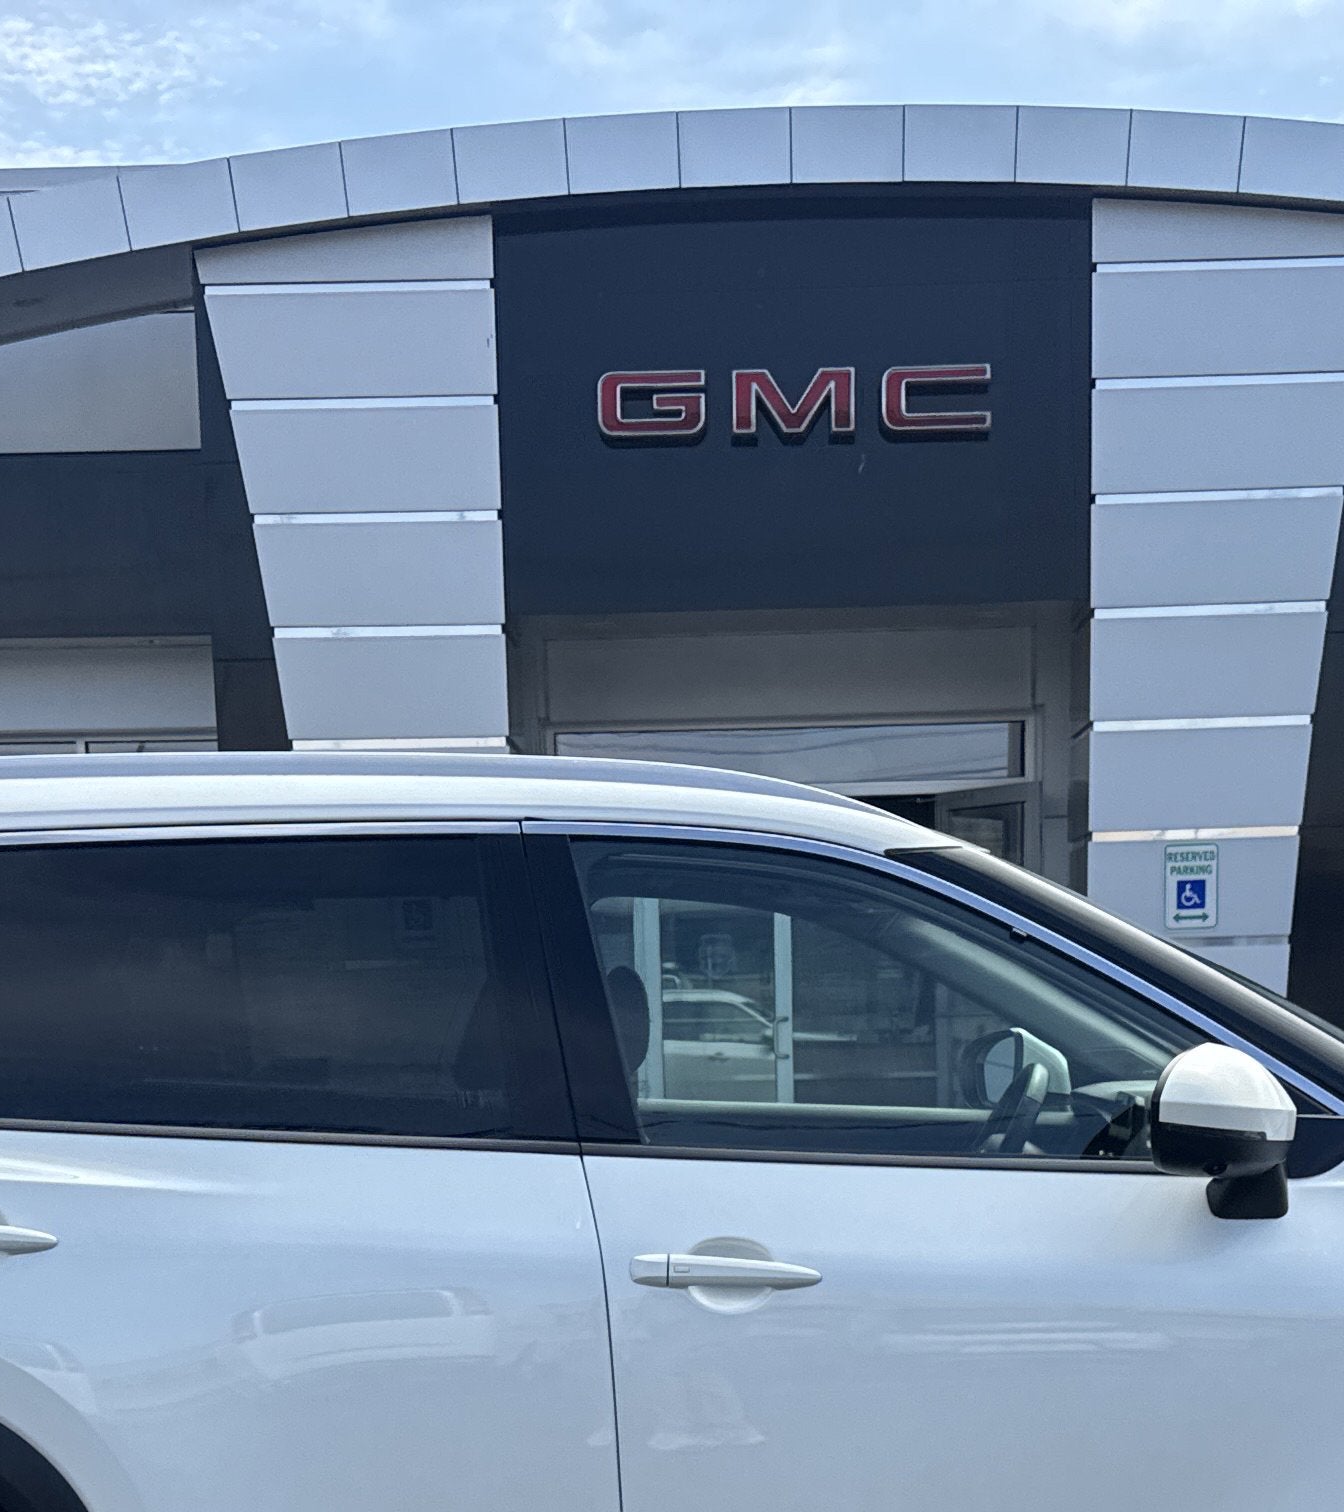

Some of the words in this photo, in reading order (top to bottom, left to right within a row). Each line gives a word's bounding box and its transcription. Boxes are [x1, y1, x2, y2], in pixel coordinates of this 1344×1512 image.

[597, 363, 992, 437] GMC
[1167, 850, 1215, 863] RESERVED
[1169, 864, 1213, 876] PARKING
